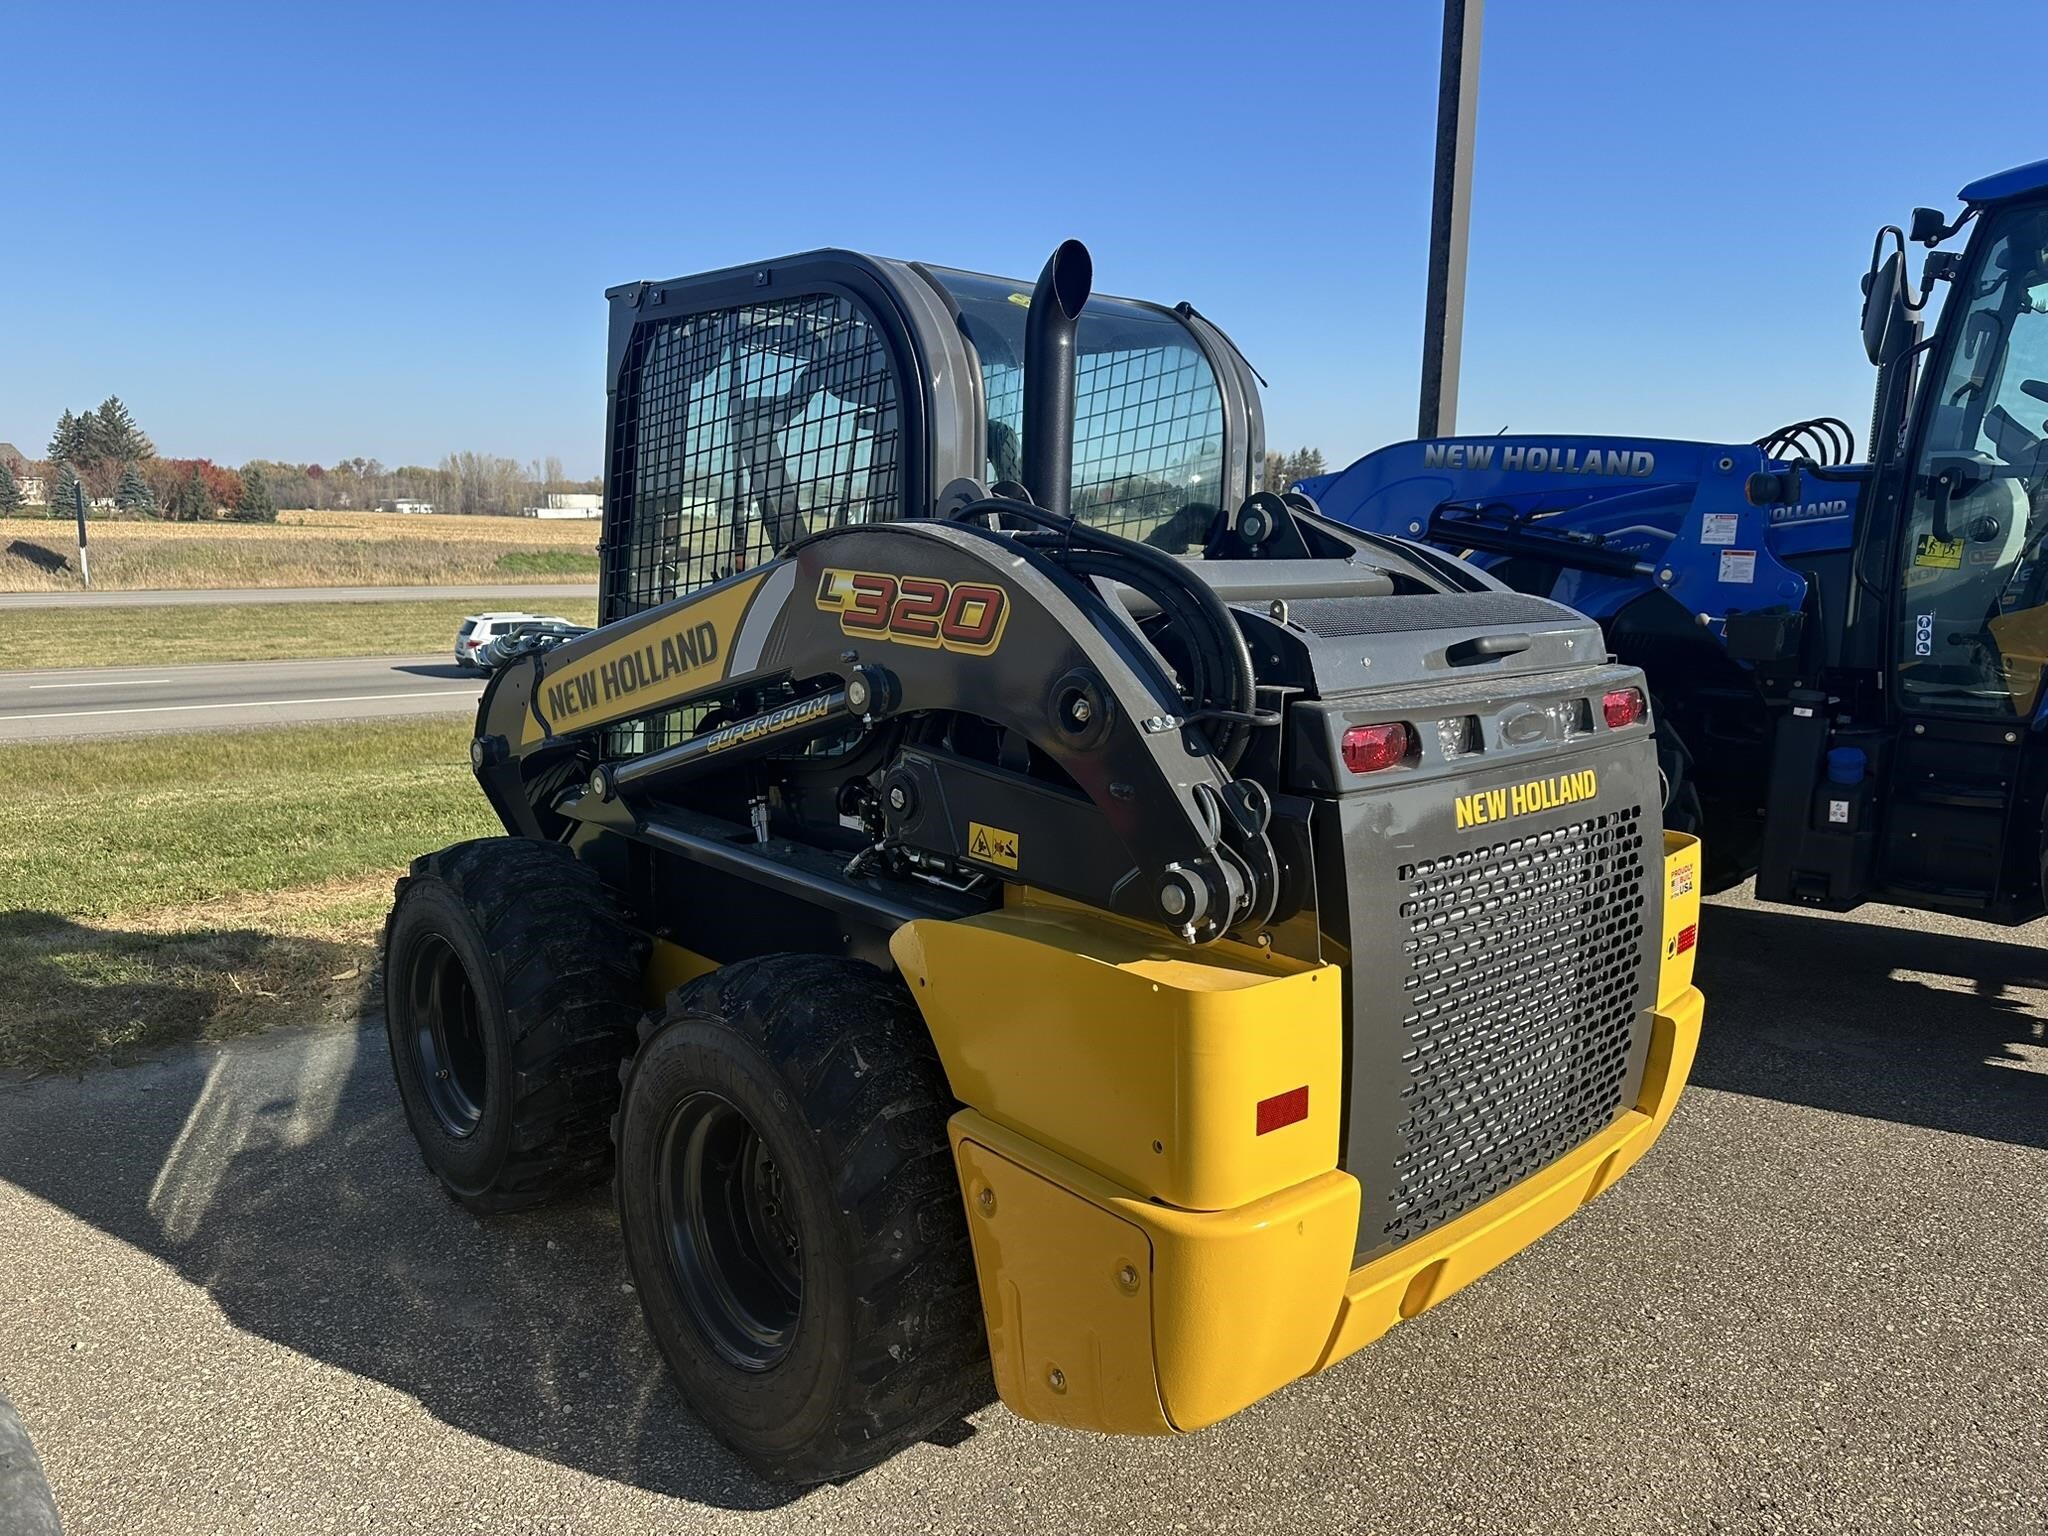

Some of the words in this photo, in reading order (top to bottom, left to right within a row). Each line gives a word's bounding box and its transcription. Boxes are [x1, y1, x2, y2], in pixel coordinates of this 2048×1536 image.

[1424, 444, 1494, 471] NEW
[1502, 446, 1654, 476] HOLLAND
[547, 669, 599, 721] NEW
[601, 620, 718, 702] HOLLAND
[1455, 788, 1507, 829] NEW
[1512, 770, 1597, 816] HOLLAND
[1680, 881, 1692, 894] USA
